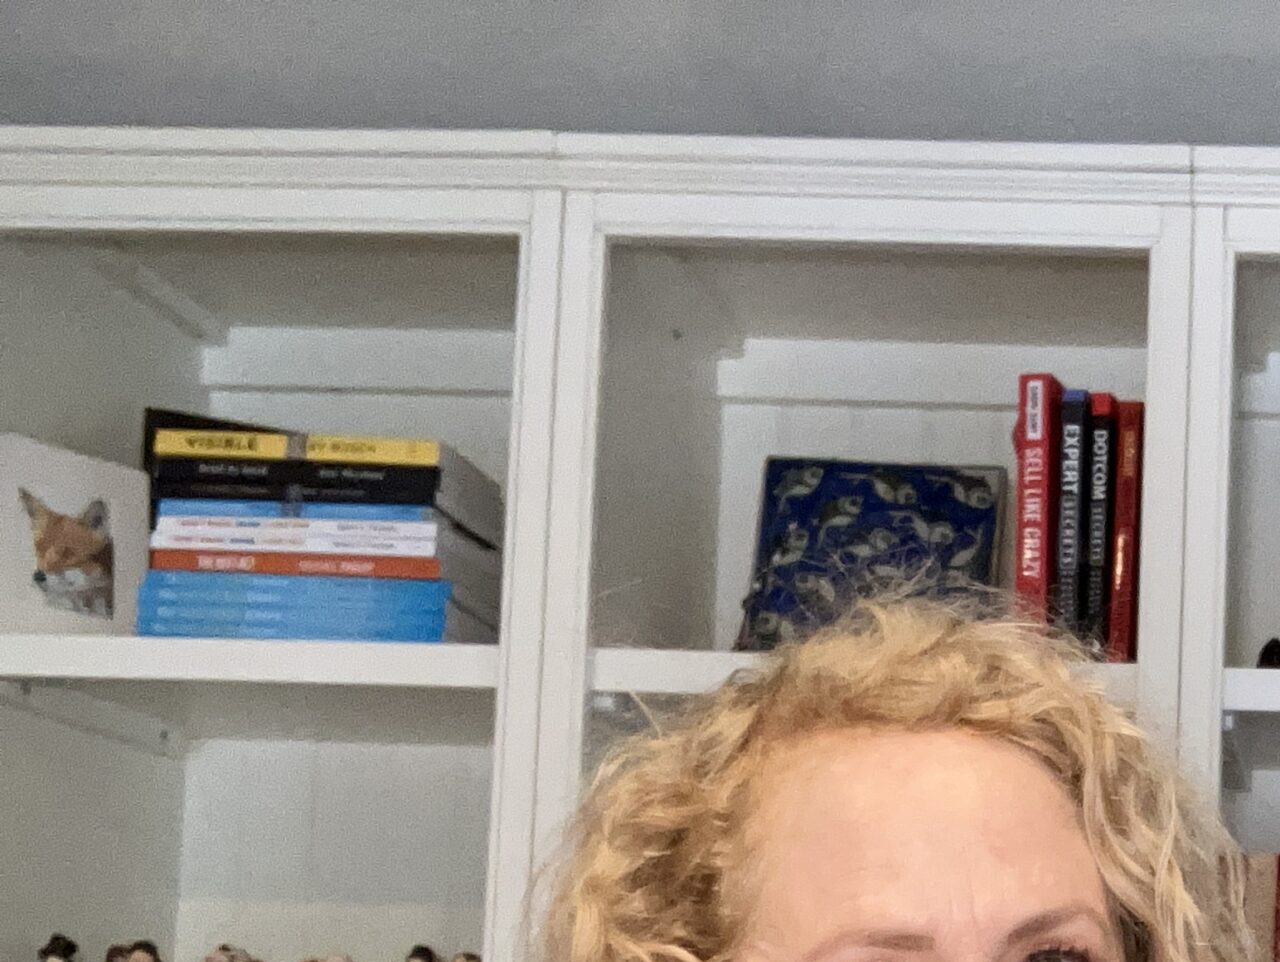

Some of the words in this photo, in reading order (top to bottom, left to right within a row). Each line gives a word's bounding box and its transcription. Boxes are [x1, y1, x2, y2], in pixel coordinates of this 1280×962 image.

[1023, 447, 1044, 485] SELL
[1062, 424, 1081, 496] EXPERT
[1091, 430, 1109, 502] DOTCOM
[1023, 488, 1043, 524] LIKE
[1061, 500, 1075, 564] SECRETS
[1089, 506, 1105, 562] SECRETS
[1021, 527, 1043, 580] CRAZY
